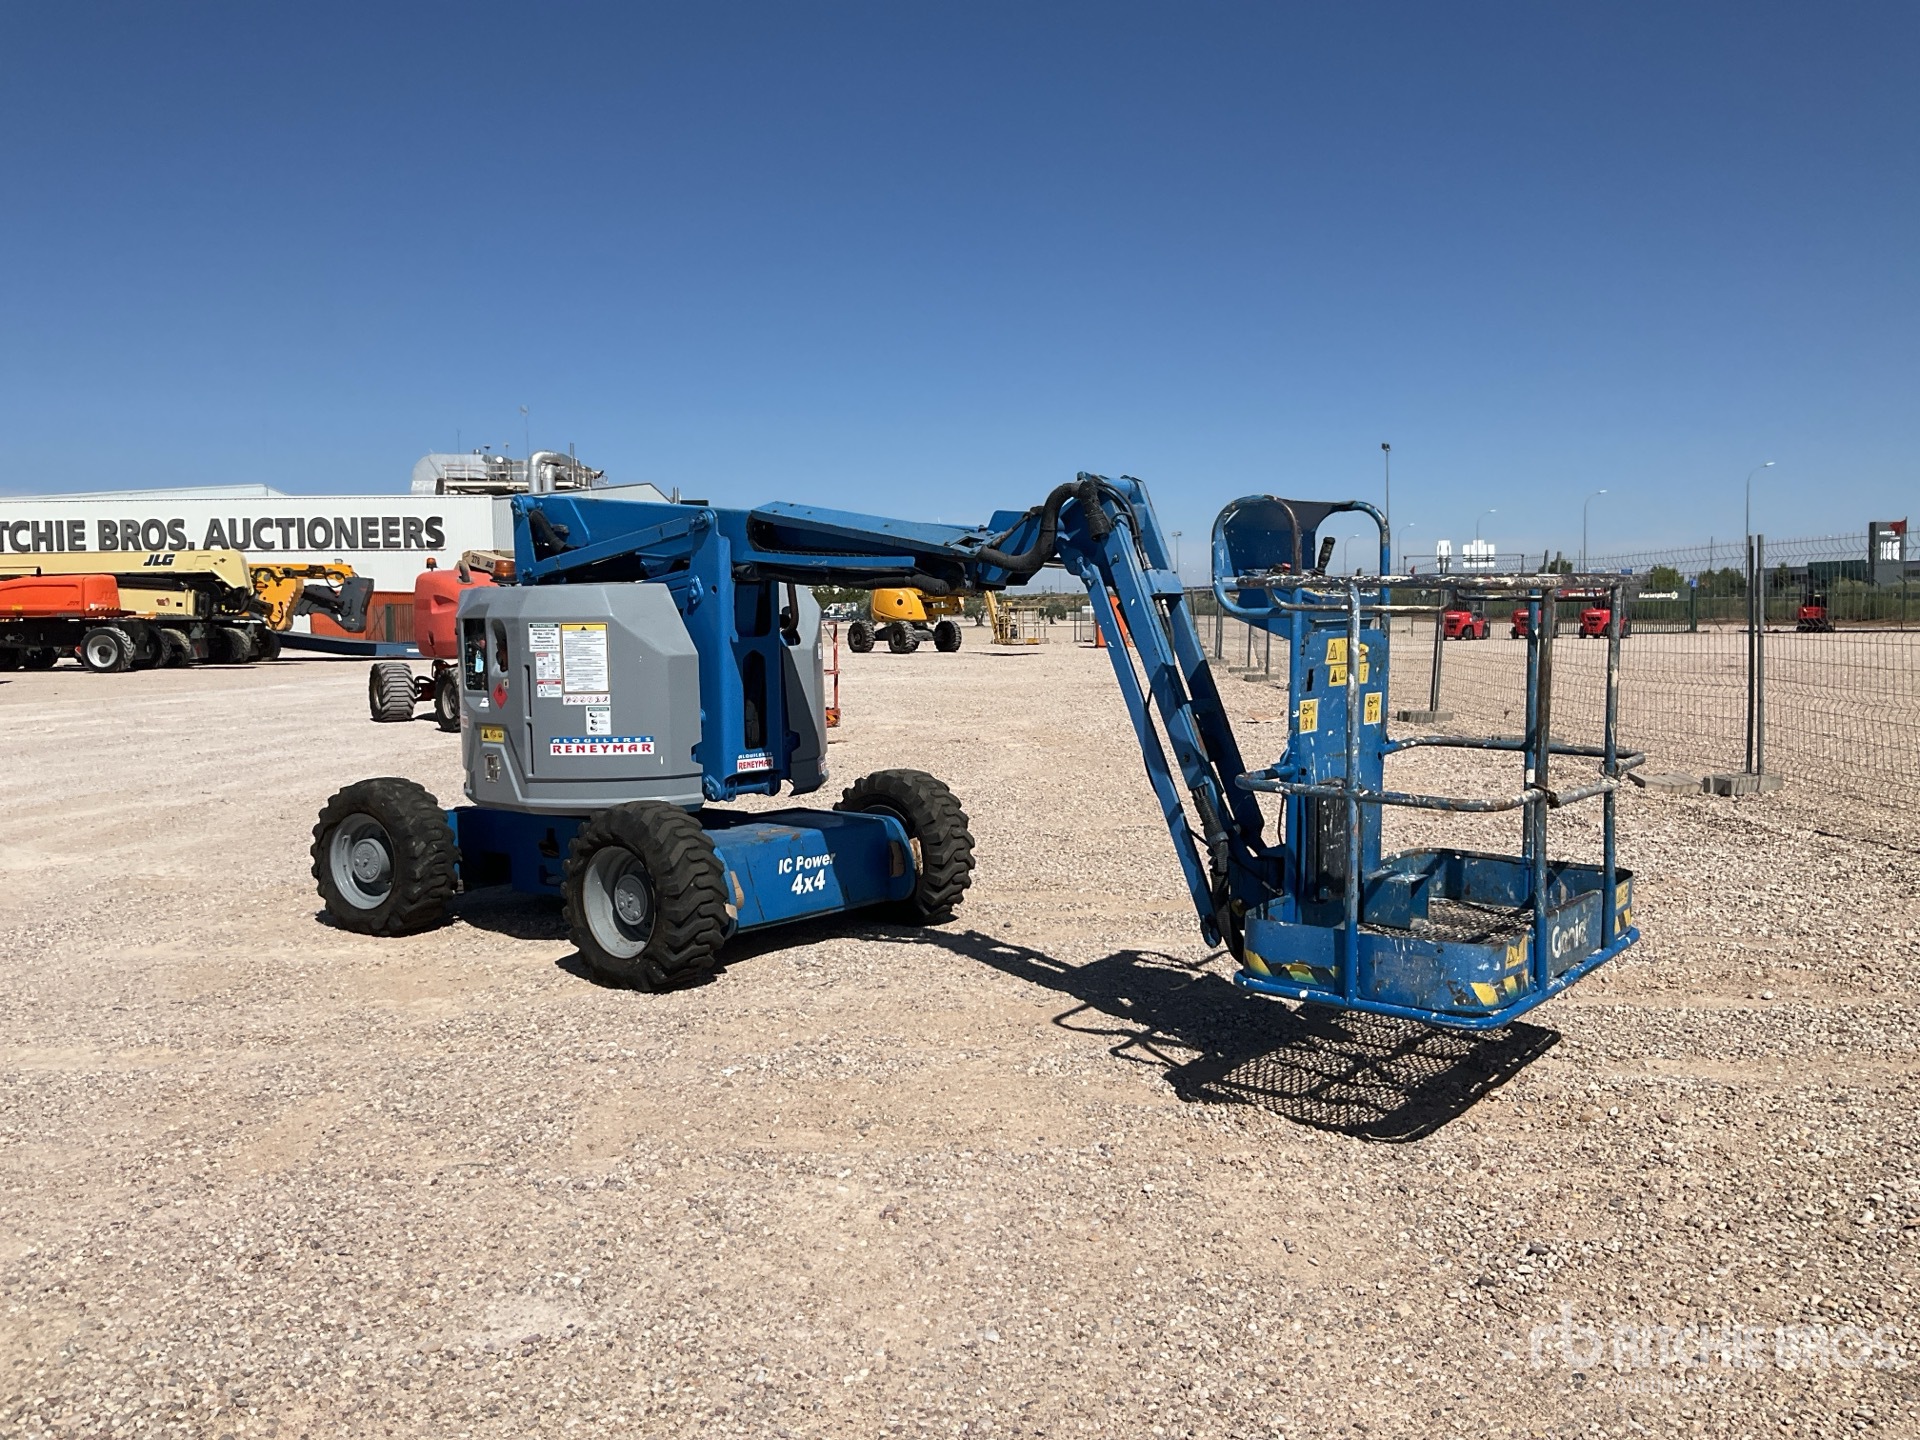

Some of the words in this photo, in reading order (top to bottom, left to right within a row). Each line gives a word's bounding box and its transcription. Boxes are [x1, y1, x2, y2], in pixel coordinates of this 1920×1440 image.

[98, 518, 195, 551] BROS.
[203, 516, 446, 551] AUCTIONEERS
[143, 553, 175, 566] JLG
[552, 743, 652, 754] RENEYMAR
[738, 759, 773, 770] RENEYMAR
[778, 857, 793, 875] IC
[795, 852, 836, 871] Power
[791, 868, 826, 895] 4x4
